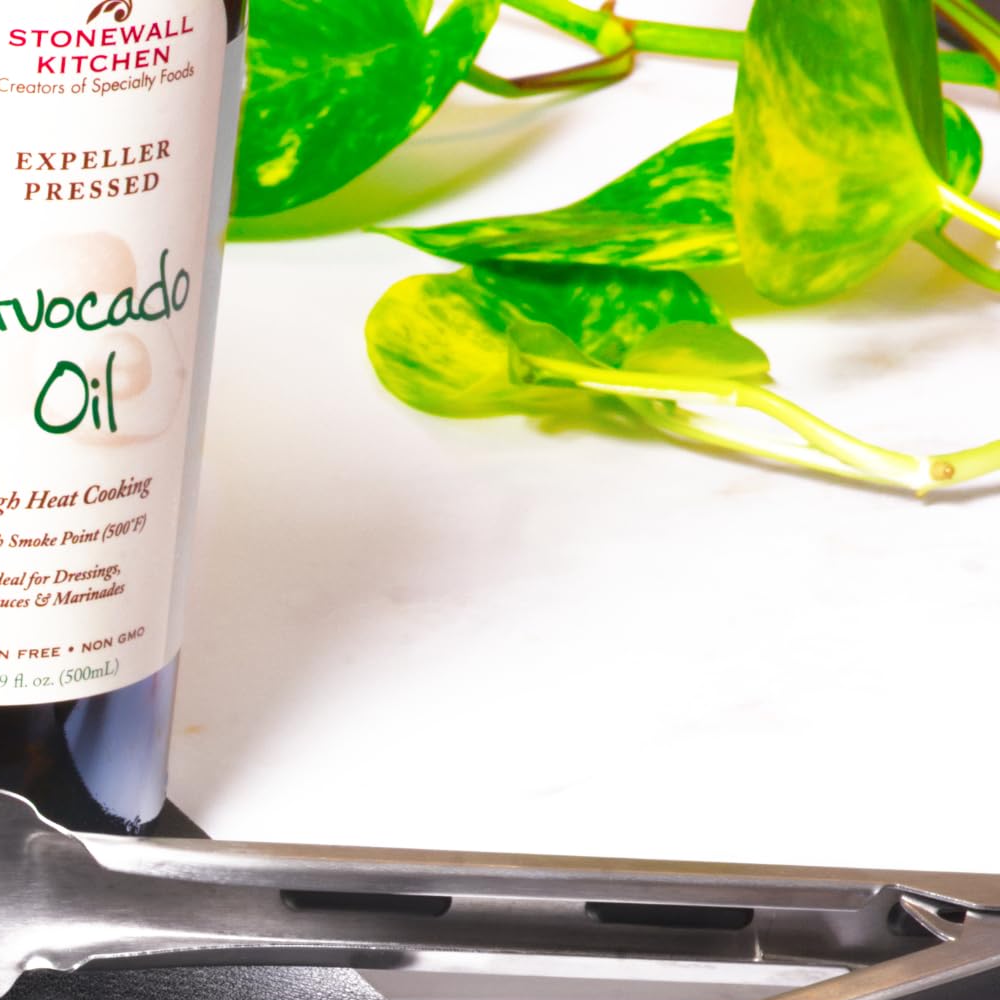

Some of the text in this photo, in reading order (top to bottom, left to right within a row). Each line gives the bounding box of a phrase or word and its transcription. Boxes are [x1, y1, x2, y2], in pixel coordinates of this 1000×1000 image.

[8, 15, 194, 48] STONEWALL
[37, 45, 170, 74] KITCHEN
[71, 77, 87, 94] of
[91, 71, 156, 96] Specialty
[160, 62, 195, 85] Foods
[15, 139, 171, 171] EXPELLER
[24, 172, 160, 202] PRESSED
[34, 351, 117, 434] Oil
[24, 490, 78, 510] Heat
[83, 476, 152, 505] Cooking
[8, 532, 58, 548] Smoke
[60, 528, 100, 546] Point
[24, 572, 50, 590] for
[53, 563, 122, 584] Dressings,
[35, 593, 51, 607] &
[52, 582, 125, 606] Marinades
[17, 647, 61, 659] FREE
[81, 637, 113, 653] NON
[118, 626, 145, 644] GMO
[33, 677, 54, 688] oz.
[58, 658, 120, 687] (500mL)
